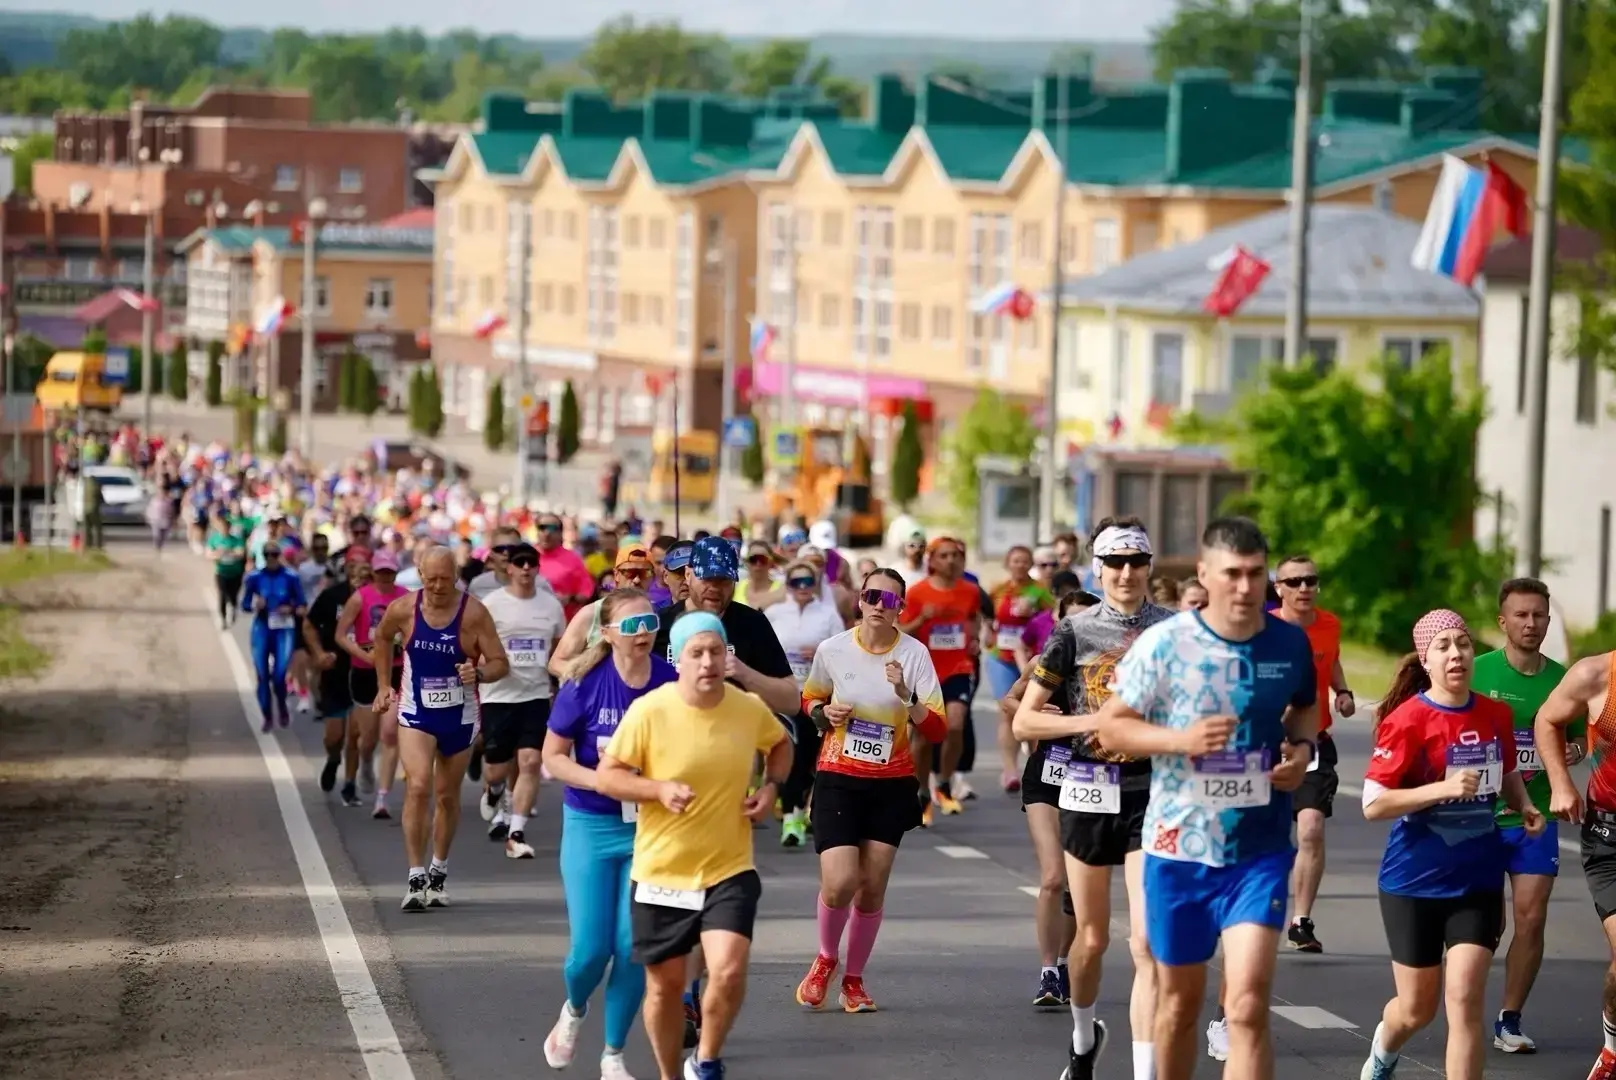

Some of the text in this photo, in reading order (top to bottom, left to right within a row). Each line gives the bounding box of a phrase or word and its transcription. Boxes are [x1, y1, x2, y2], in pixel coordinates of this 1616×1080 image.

[414, 639, 456, 655] RUSSIA
[428, 691, 452, 703] 1221
[853, 739, 883, 757] 1196
[1049, 765, 1066, 780] 14
[1068, 787, 1103, 805] 428
[1203, 779, 1254, 798] 1284
